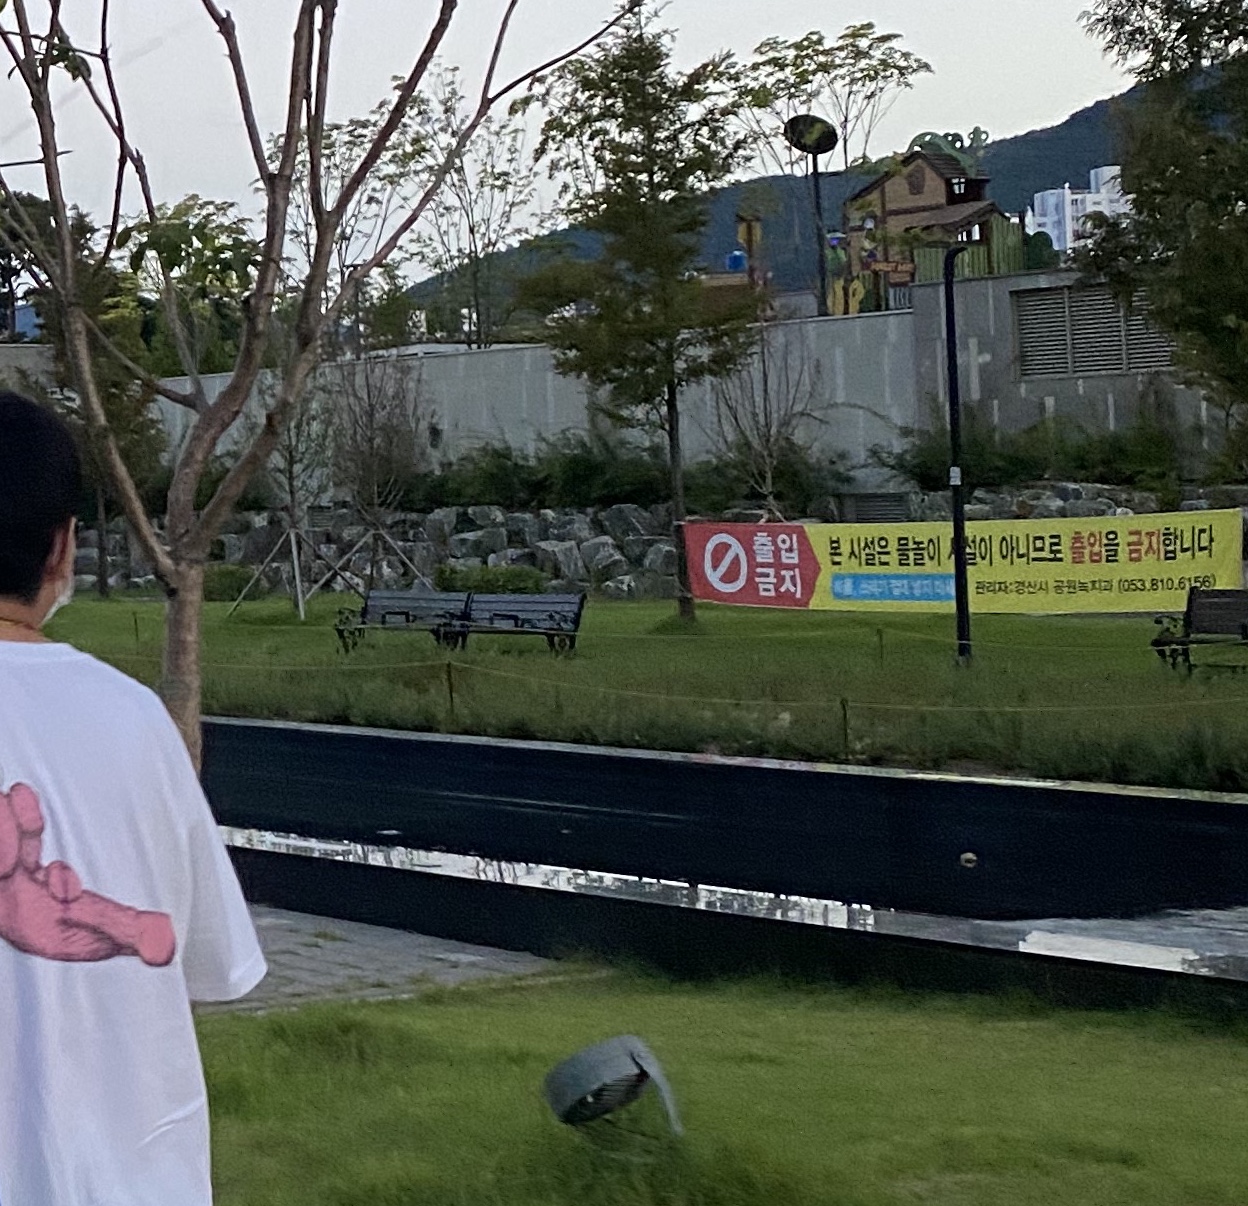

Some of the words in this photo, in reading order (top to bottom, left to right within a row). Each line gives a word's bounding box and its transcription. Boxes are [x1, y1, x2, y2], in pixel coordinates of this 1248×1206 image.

[753, 532, 799, 564] 출입
[829, 536, 842, 566] 본
[848, 536, 891, 567] 시설은
[897, 536, 941, 567] 물놀이
[999, 533, 1064, 565] 아니므로
[1071, 530, 1120, 564] 출입을
[1127, 524, 1215, 563] 금지합니다
[755, 567, 802, 599] 금지
